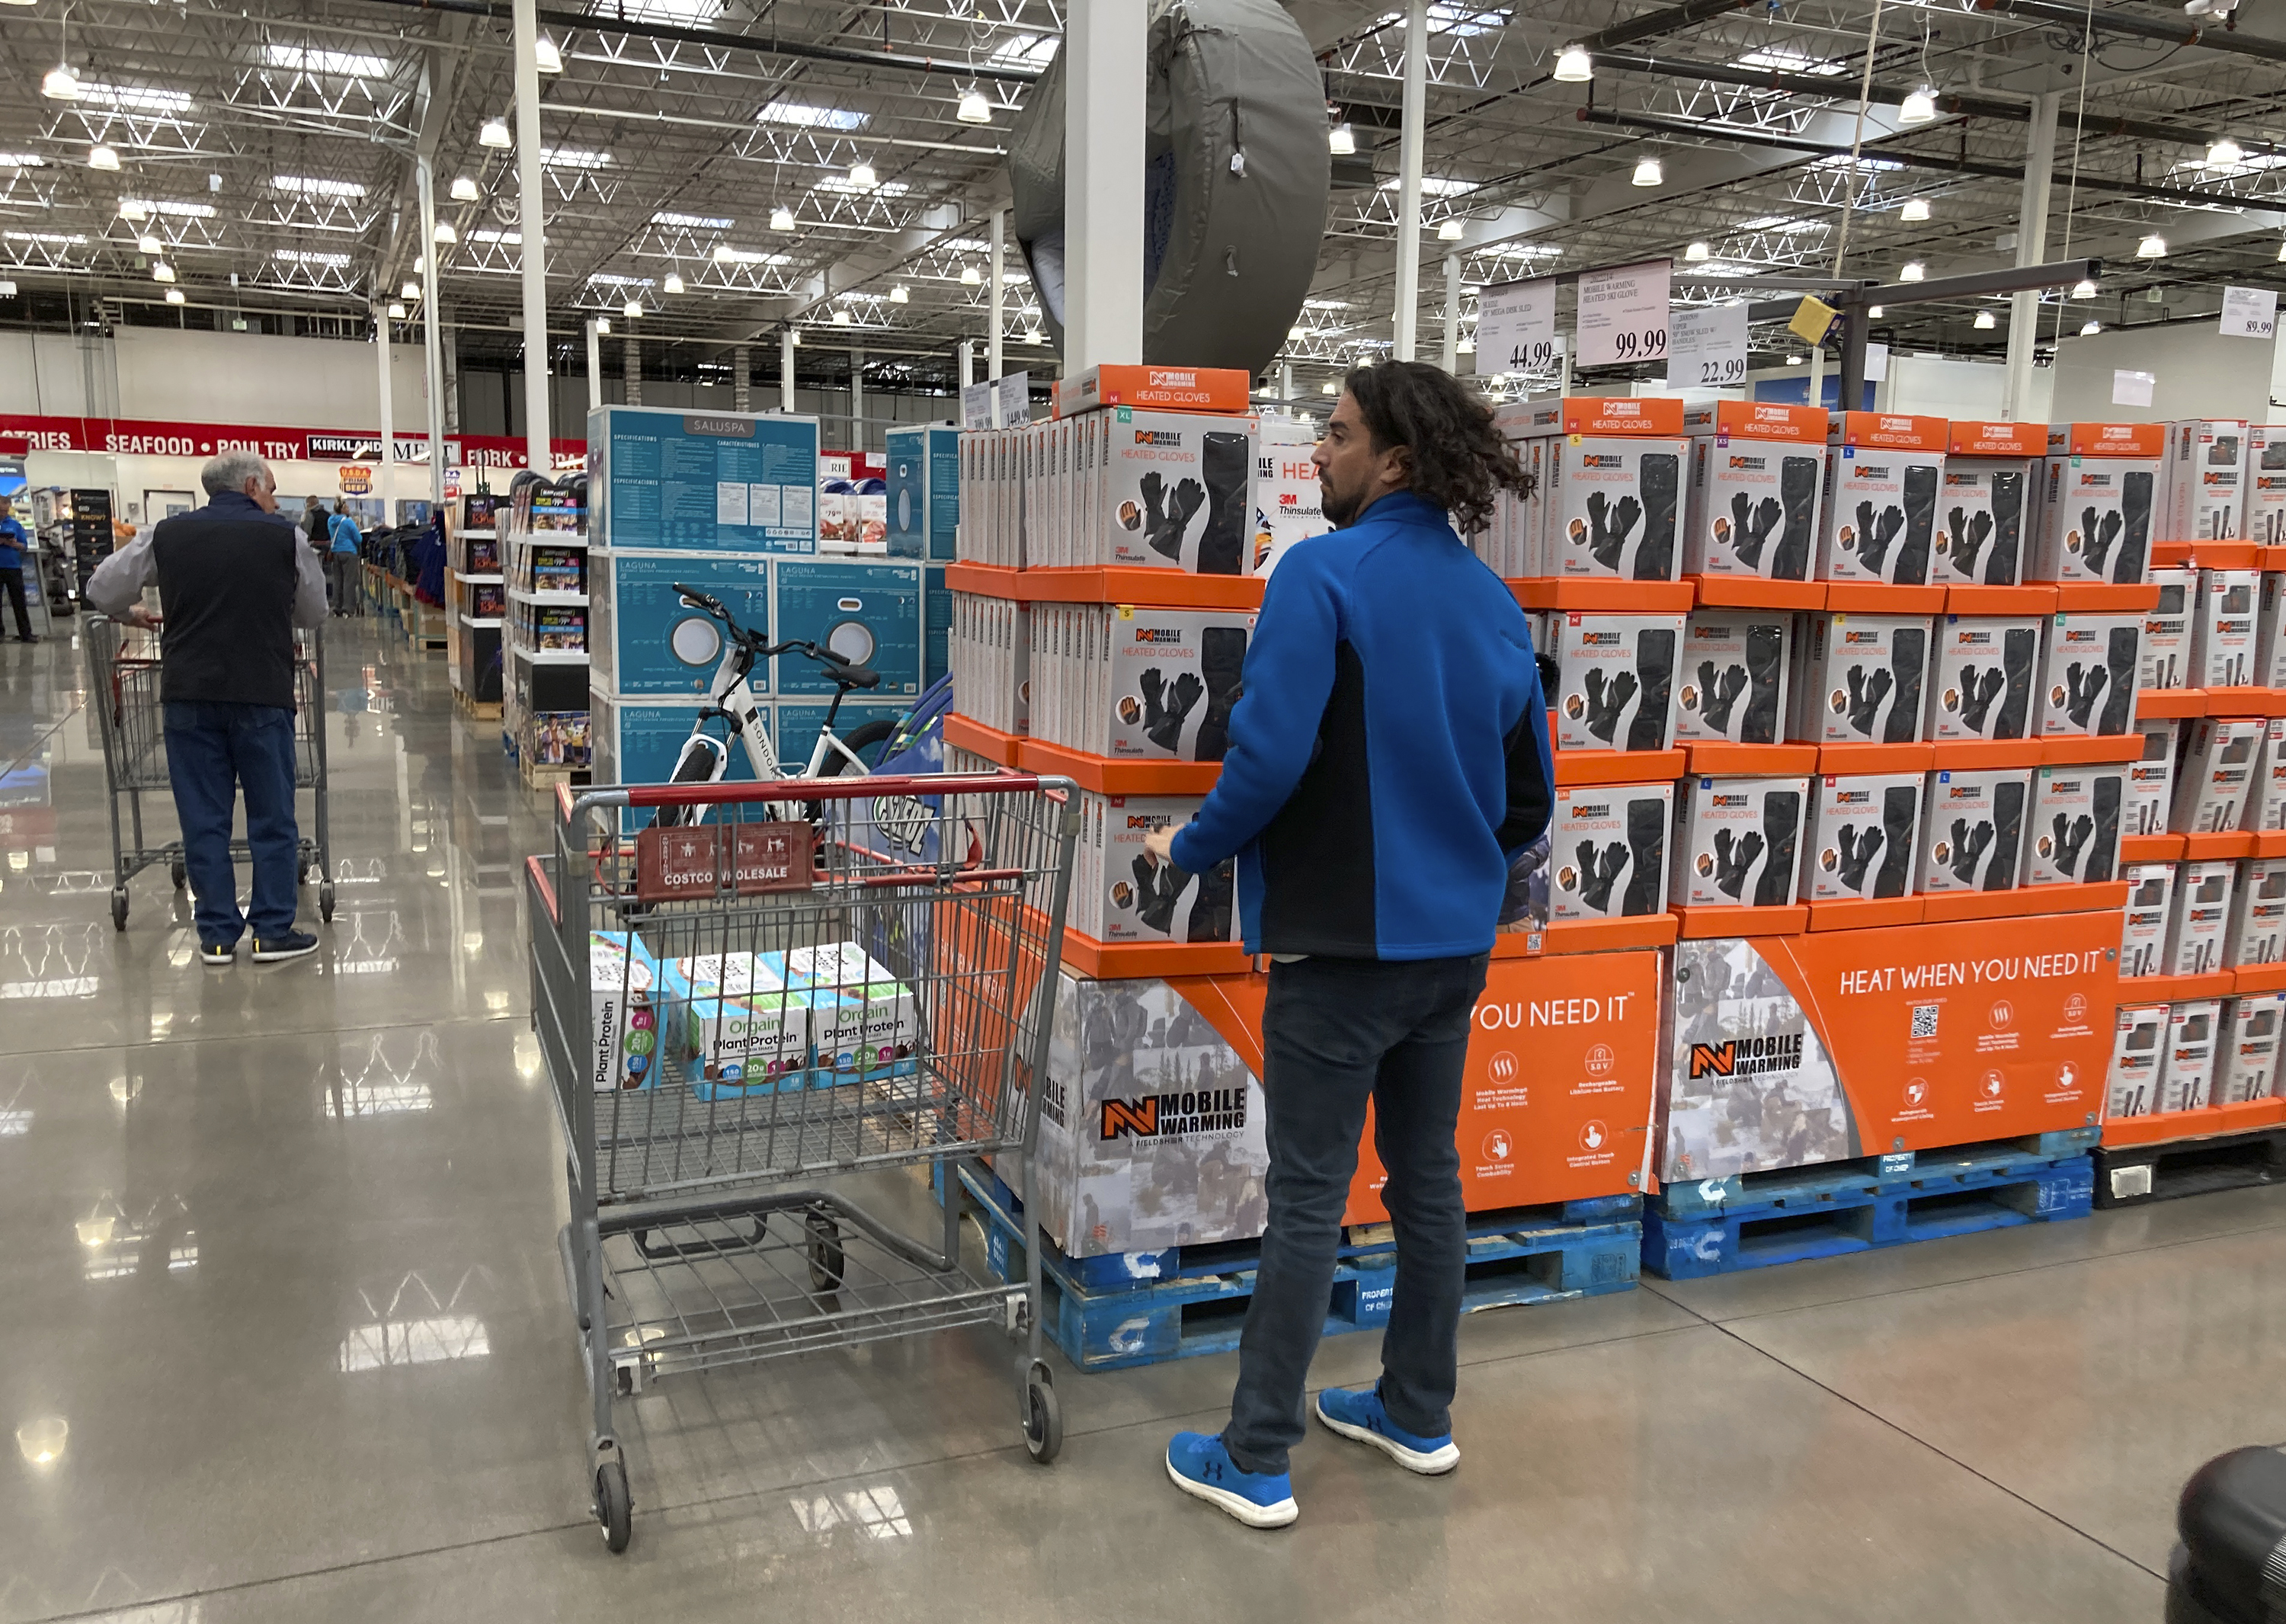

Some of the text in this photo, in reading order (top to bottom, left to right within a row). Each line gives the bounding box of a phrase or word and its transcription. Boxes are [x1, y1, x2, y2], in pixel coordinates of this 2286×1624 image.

[1618, 288, 1638, 299] GLOVE
[2246, 320, 2272, 335] 89.99
[1615, 329, 1666, 360] 99.99
[1510, 341, 1552, 368] 44.99
[1701, 359, 1744, 383] 22.99
[1167, 373, 1196, 381] MOBILE
[1136, 390, 1210, 403] HEATED GLOVES
[693, 420, 745, 433] SALUSPA
[1593, 420, 1653, 429] HEATED GLOVES
[1744, 424, 1800, 435] HEATED GLOVES
[1154, 431, 1181, 440] MOBILE
[105, 434, 194, 455] SEAFOOD
[217, 439, 299, 460] POULTRY
[312, 439, 383, 453] KIRKLAND
[1121, 449, 1196, 463] HEATED GLOVES
[1571, 472, 1633, 482] HEATED GLOVES
[345, 484, 367, 492] BEEF
[1844, 483, 1870, 492] HEATED
[1279, 493, 1297, 504] 3M
[1279, 506, 1321, 516] Thinsulate
[1115, 546, 1129, 554] 3M
[1115, 554, 1145, 562] Thinsulate
[620, 562, 657, 570] LAGUNA
[781, 567, 815, 575] LAGUNA
[1154, 629, 1180, 637] MOBILE
[1122, 647, 1194, 658] HEATED GLOVES
[1570, 649, 1631, 658] HEATED GLOVES
[624, 710, 661, 719] LAGUNA
[781, 709, 816, 718] LAGUNA
[1115, 739, 1127, 748] 3M
[1826, 806, 1878, 815] HEATED GLOVES
[1964, 801, 1989, 809] GLOVES
[1701, 810, 1758, 819] HEATED GLOVES
[1561, 821, 1621, 831] HEATED GLOVES
[1113, 834, 1145, 843] HEATED
[664, 872, 712, 886] COSTCO
[1840, 968, 1895, 995] HEAT
[1900, 962, 1965, 989] WHEN
[1971, 957, 2019, 983] YOU
[2024, 953, 2079, 979] NEED
[838, 1004, 888, 1023] Orgain
[1530, 998, 1599, 1027] NEED
[729, 1017, 781, 1036] Orgain
[824, 1027, 857, 1039] Plant
[595, 1001, 613, 1082] Plant Protein
[713, 1033, 797, 1050] Plant Protein
[1736, 1033, 1802, 1059] MOBILE
[1736, 1054, 1800, 1075] WARMING
[1044, 1075, 1065, 1110] BILE
[1161, 1087, 1245, 1116] MOBILE
[1160, 1111, 1244, 1136] WARMING
[1185, 1131, 1244, 1142] TECHNOLOGY
